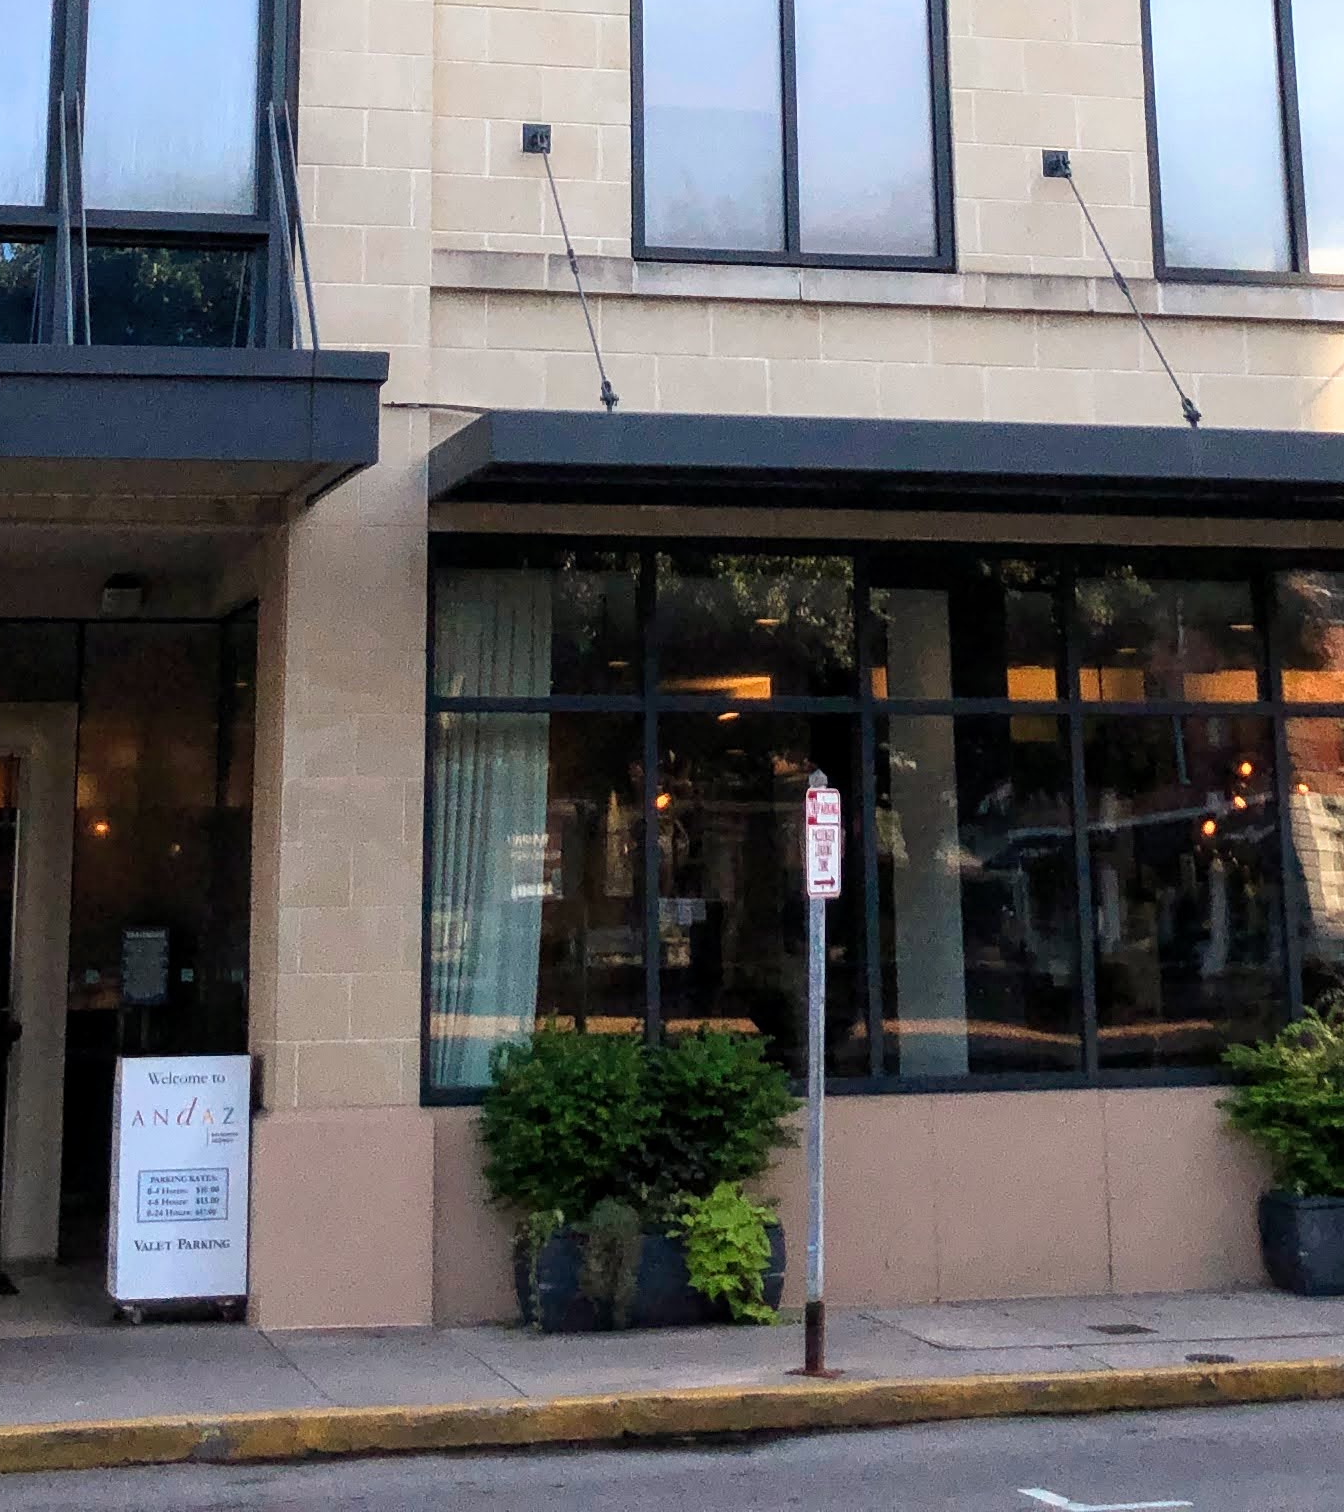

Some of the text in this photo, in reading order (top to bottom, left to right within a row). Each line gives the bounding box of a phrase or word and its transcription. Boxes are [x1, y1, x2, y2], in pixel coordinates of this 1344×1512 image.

[148, 1071, 226, 1085] Welcome to
[131, 1096, 235, 1127] ANdAZ
[177, 1238, 231, 1250] PARKING
